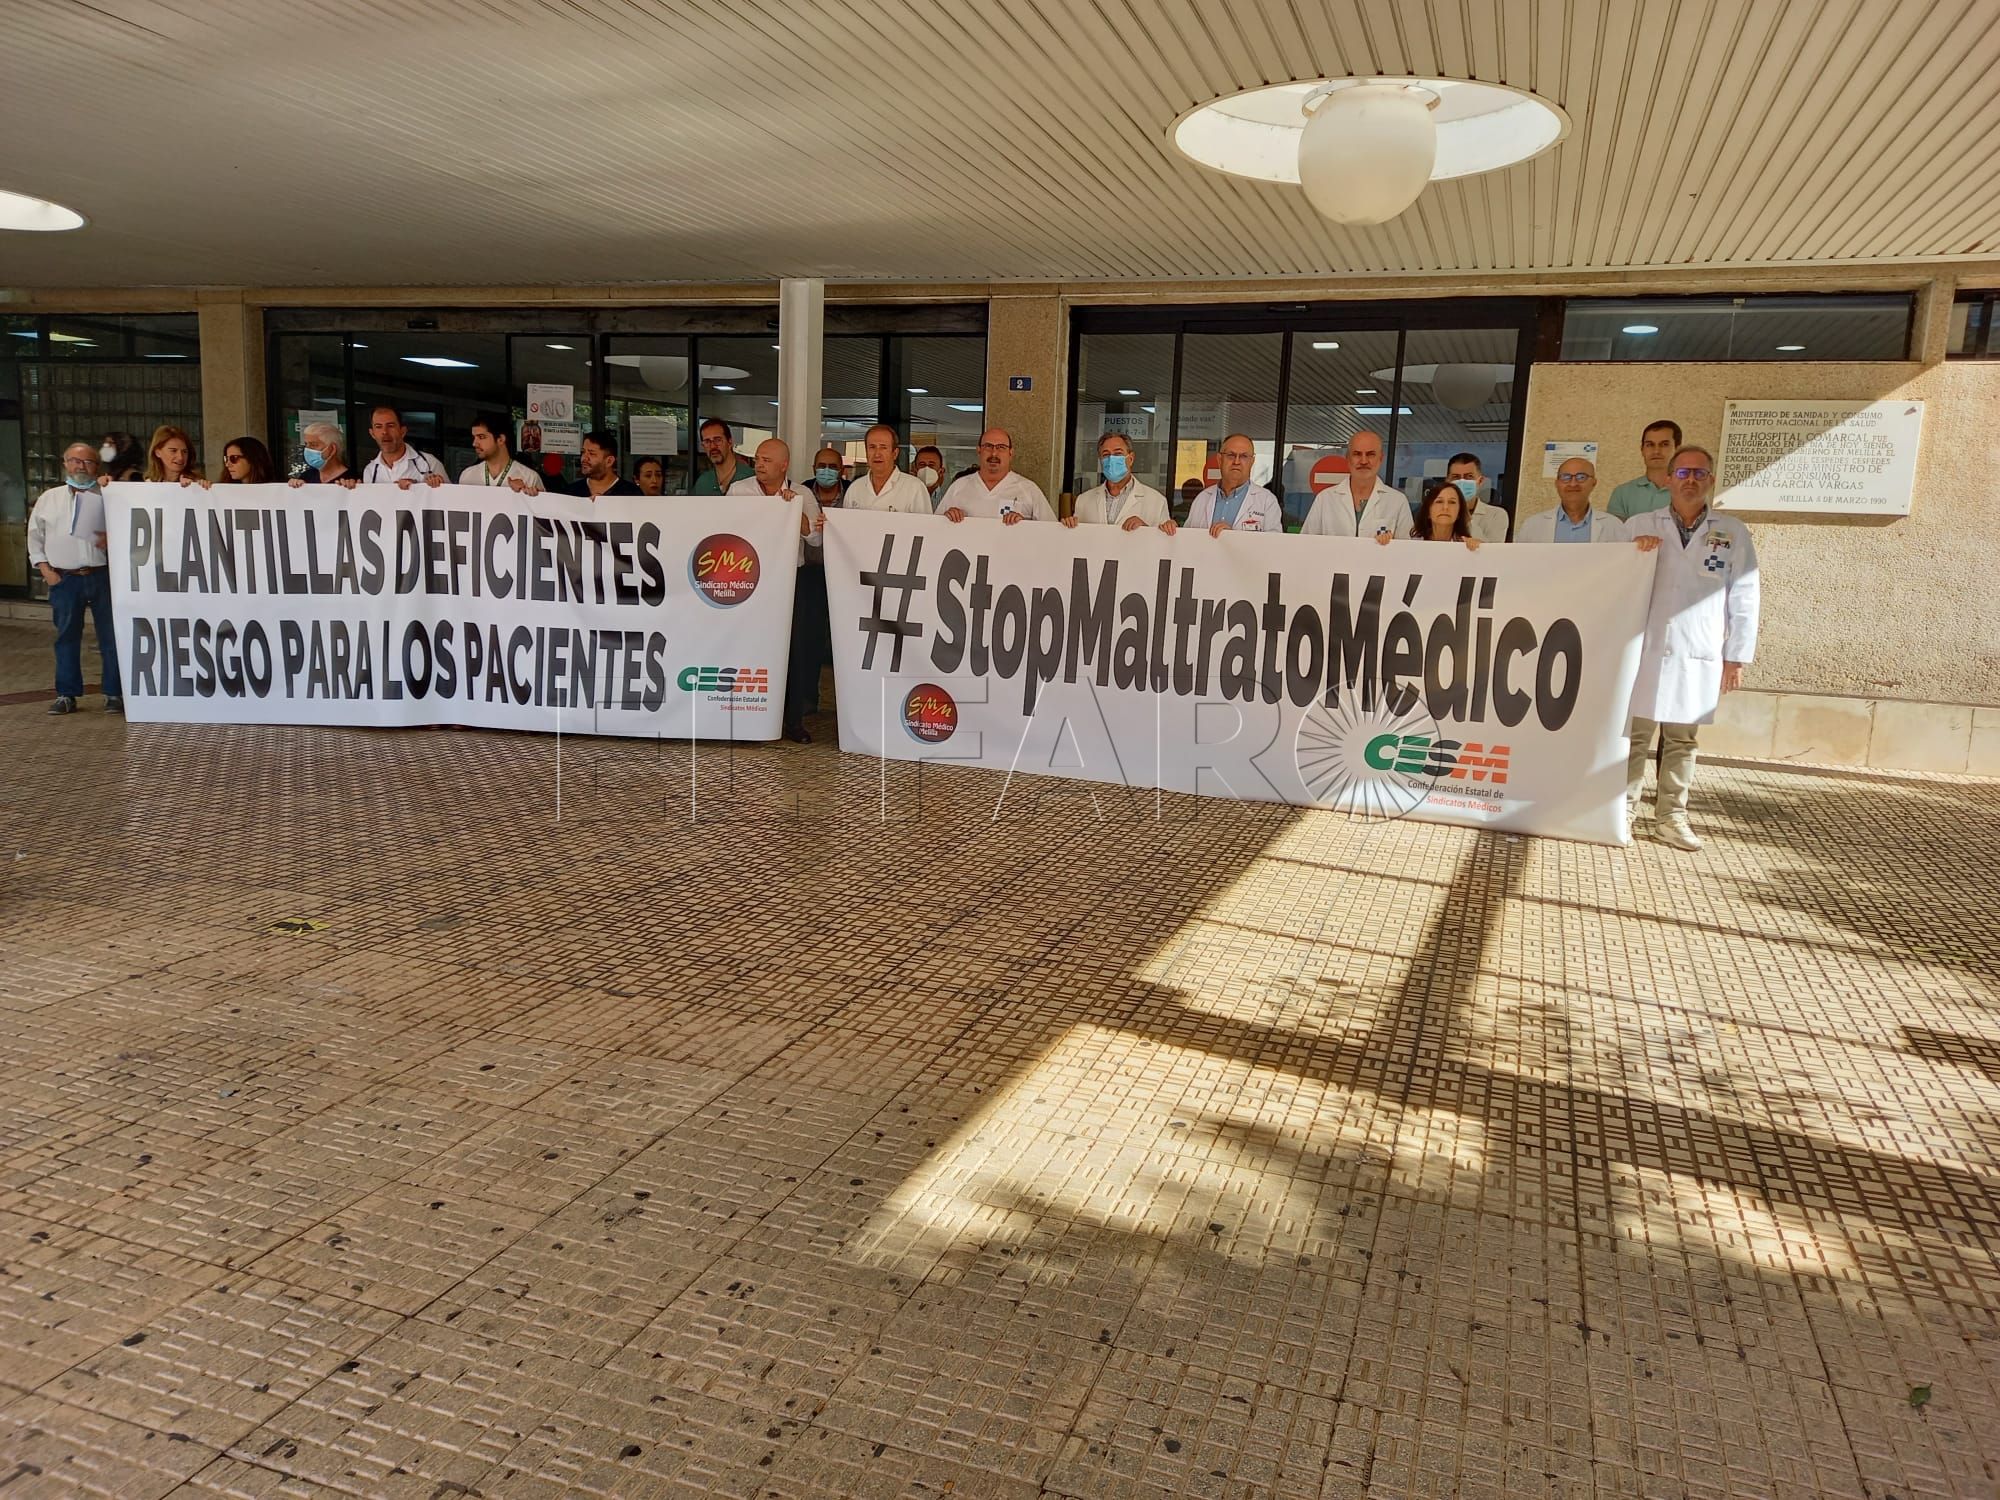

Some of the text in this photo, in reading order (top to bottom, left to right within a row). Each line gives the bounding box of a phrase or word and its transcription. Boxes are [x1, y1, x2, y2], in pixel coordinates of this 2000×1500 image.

[1016, 379, 1024, 390] 2
[1730, 410, 1778, 418] MINISTERIO
[1792, 411, 1829, 419] SANIDAD
[1841, 411, 1883, 419] CONSUMO
[1104, 417, 1144, 425] PUESTOS
[1823, 419, 1833, 427] DE
[1728, 433, 1748, 441] ESTE
[1750, 431, 1801, 441] HOSPITAL
[1806, 432, 1869, 442] COMARCAL
[1727, 440, 1780, 448] INAUGURADO
[1886, 449, 1895, 457] EL
[1811, 456, 1848, 464] CESPEDES
[1724, 463, 1741, 471] POR
[1744, 463, 1752, 471] EL
[1812, 464, 1865, 473] MINISTRO
[1868, 464, 1883, 473] DE
[1723, 470, 1841, 481] SANIDAD Y CONSUMO
[1772, 479, 1814, 489] GARCIA
[1818, 480, 1864, 490] VARGAS
[1779, 495, 1813, 503] MELILLA
[1835, 496, 1867, 505] MARZO
[1870, 497, 1887, 505] 1990
[130, 507, 666, 608] PLANTILLAS DEFICIENTES
[694, 580, 755, 590] Sindicato Médico
[713, 589, 736, 598] Melilla
[859, 533, 1582, 732] #StopMaltratoMédico
[131, 617, 667, 712] RIESGO PARA LOS PACIENTES
[677, 666, 768, 693] CESM
[707, 695, 742, 703] Confederación
[720, 704, 768, 713] Sindicatos Médicos
[904, 719, 954, 731] Sindicato Médico
[1363, 733, 1511, 785] CESM
[1407, 779, 1504, 799] Confederación Estatal de
[1426, 795, 1502, 813] Sindicatos Médicos
